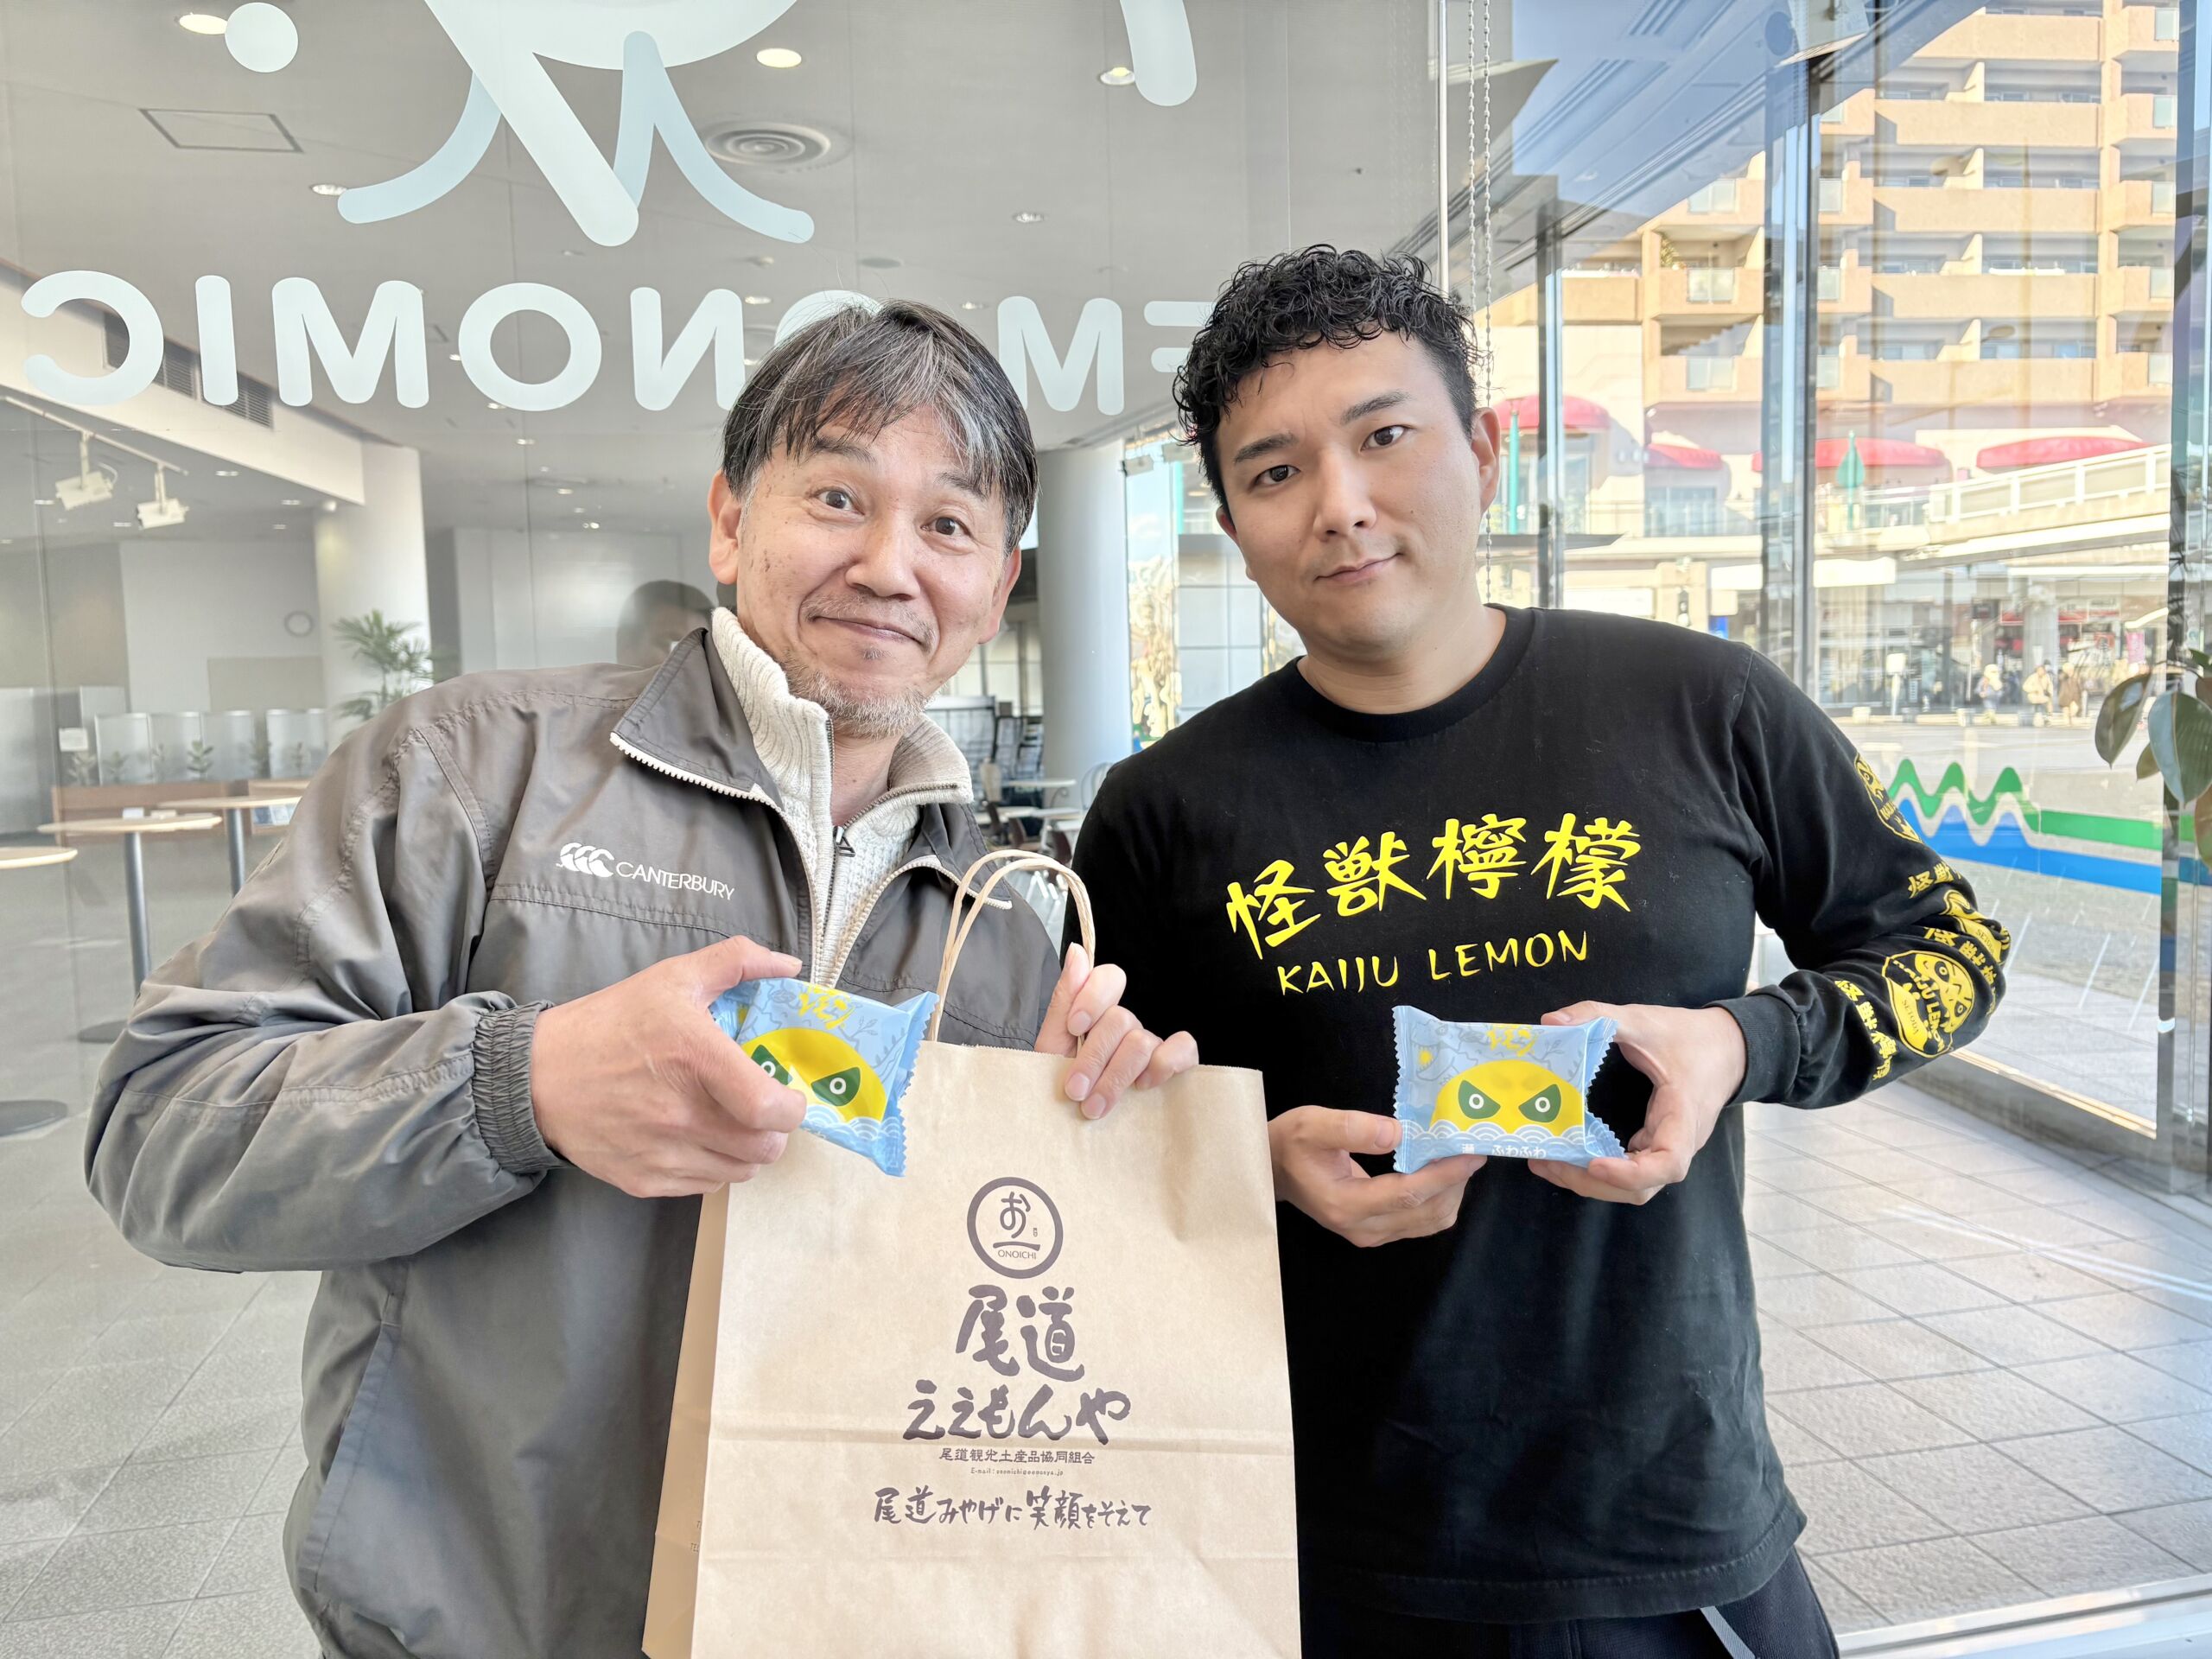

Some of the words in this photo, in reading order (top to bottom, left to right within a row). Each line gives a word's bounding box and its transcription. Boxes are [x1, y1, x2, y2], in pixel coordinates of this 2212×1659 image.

[615, 861, 735, 900] CANTERBURY
[1225, 812, 1641, 960] 怪獣檸檬
[1277, 956, 1399, 996] KAIJU
[1428, 930, 1587, 981] LEMON
[997, 1249, 1037, 1260] ONOICHI
[956, 1284, 1085, 1382] 尾道
[903, 1379, 1131, 1445] ええもんや
[938, 1447, 1096, 1465] 尾道観光土産品協同組合
